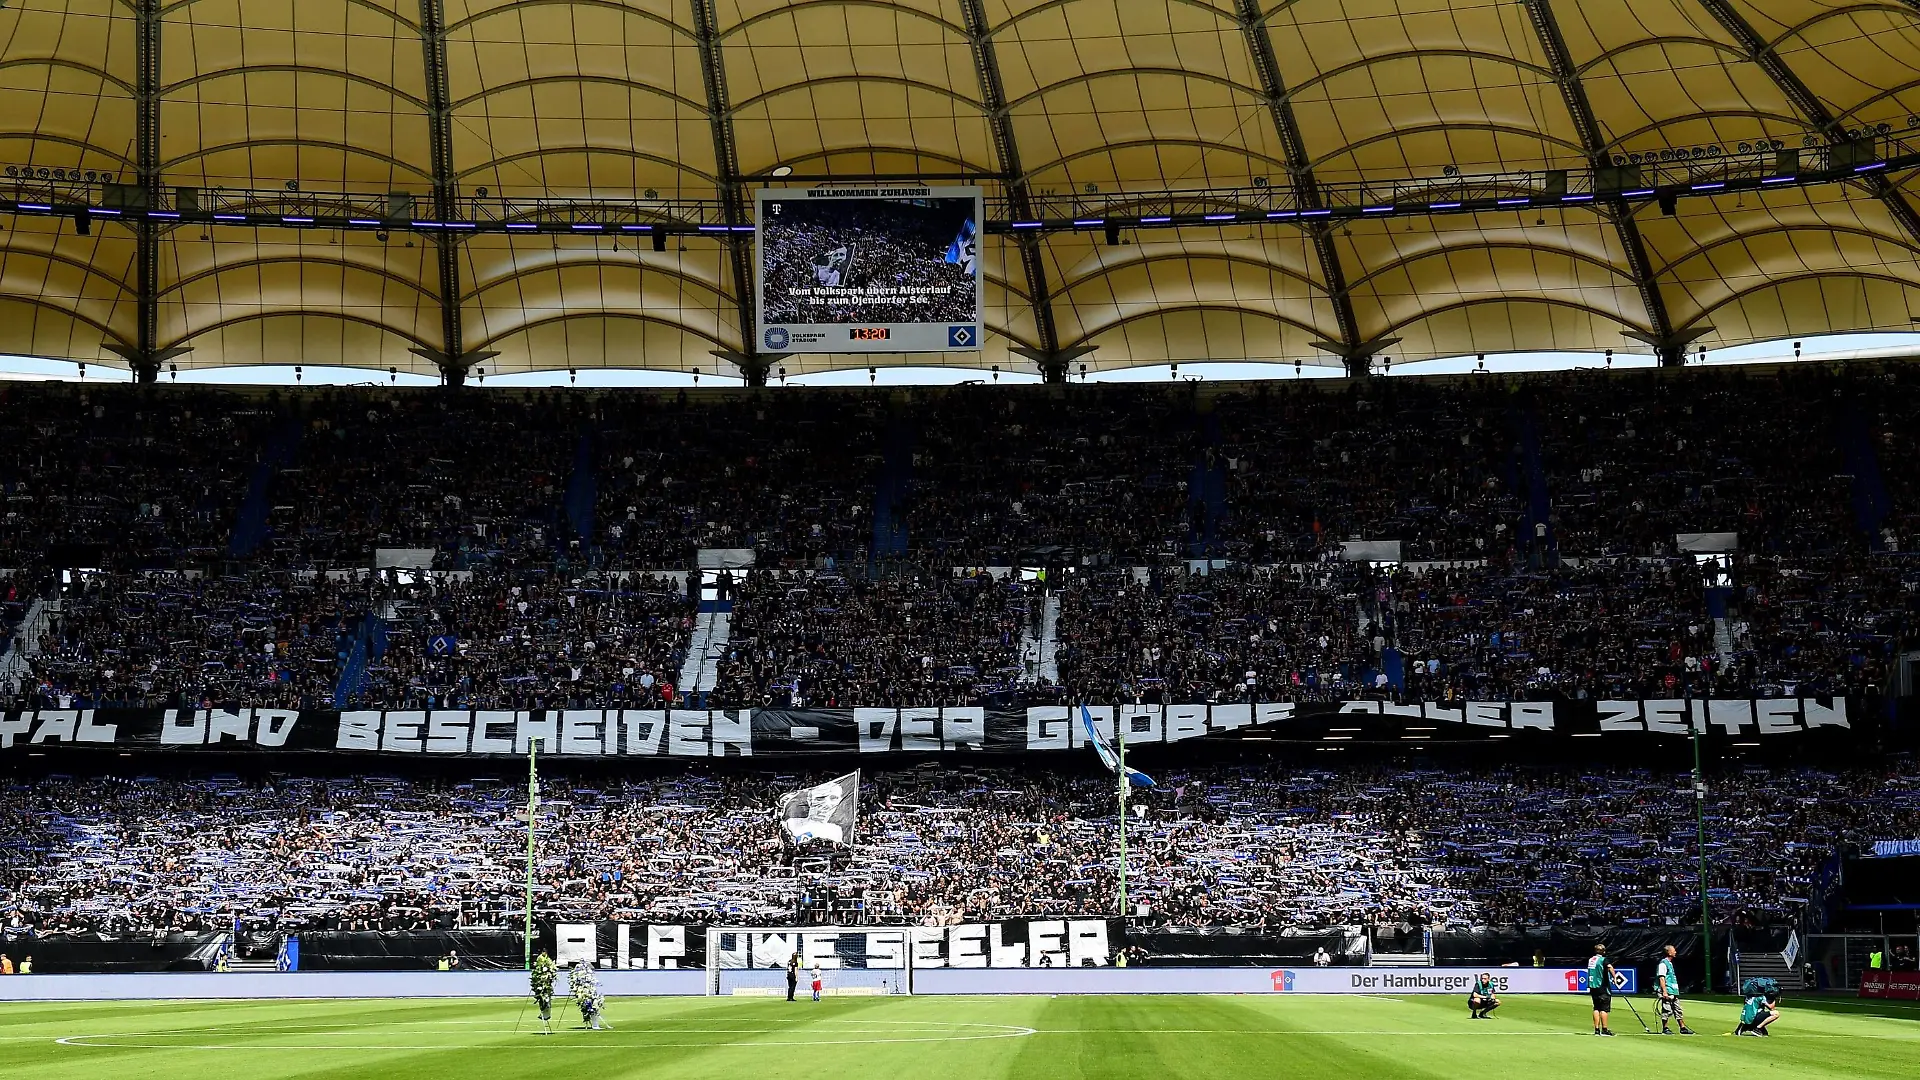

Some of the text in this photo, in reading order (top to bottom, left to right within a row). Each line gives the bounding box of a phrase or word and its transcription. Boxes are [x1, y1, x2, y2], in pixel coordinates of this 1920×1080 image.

[807, 188, 931, 198] WILLKOMMEN ZUHAUSE!
[788, 285, 951, 297] Vom Volkspark übern Alsterlauf
[809, 296, 825, 305] bis
[827, 297, 849, 305] zum
[854, 328, 886, 341] 13:20
[161, 708, 299, 746] UND
[336, 709, 752, 757] BESCHEIDEN
[853, 706, 985, 752] DER
[1596, 696, 1851, 735] ZEITEN
[713, 932, 840, 969] UWE
[865, 919, 1111, 969] SEELER
[1351, 973, 1509, 991] Der Hamburger eg
